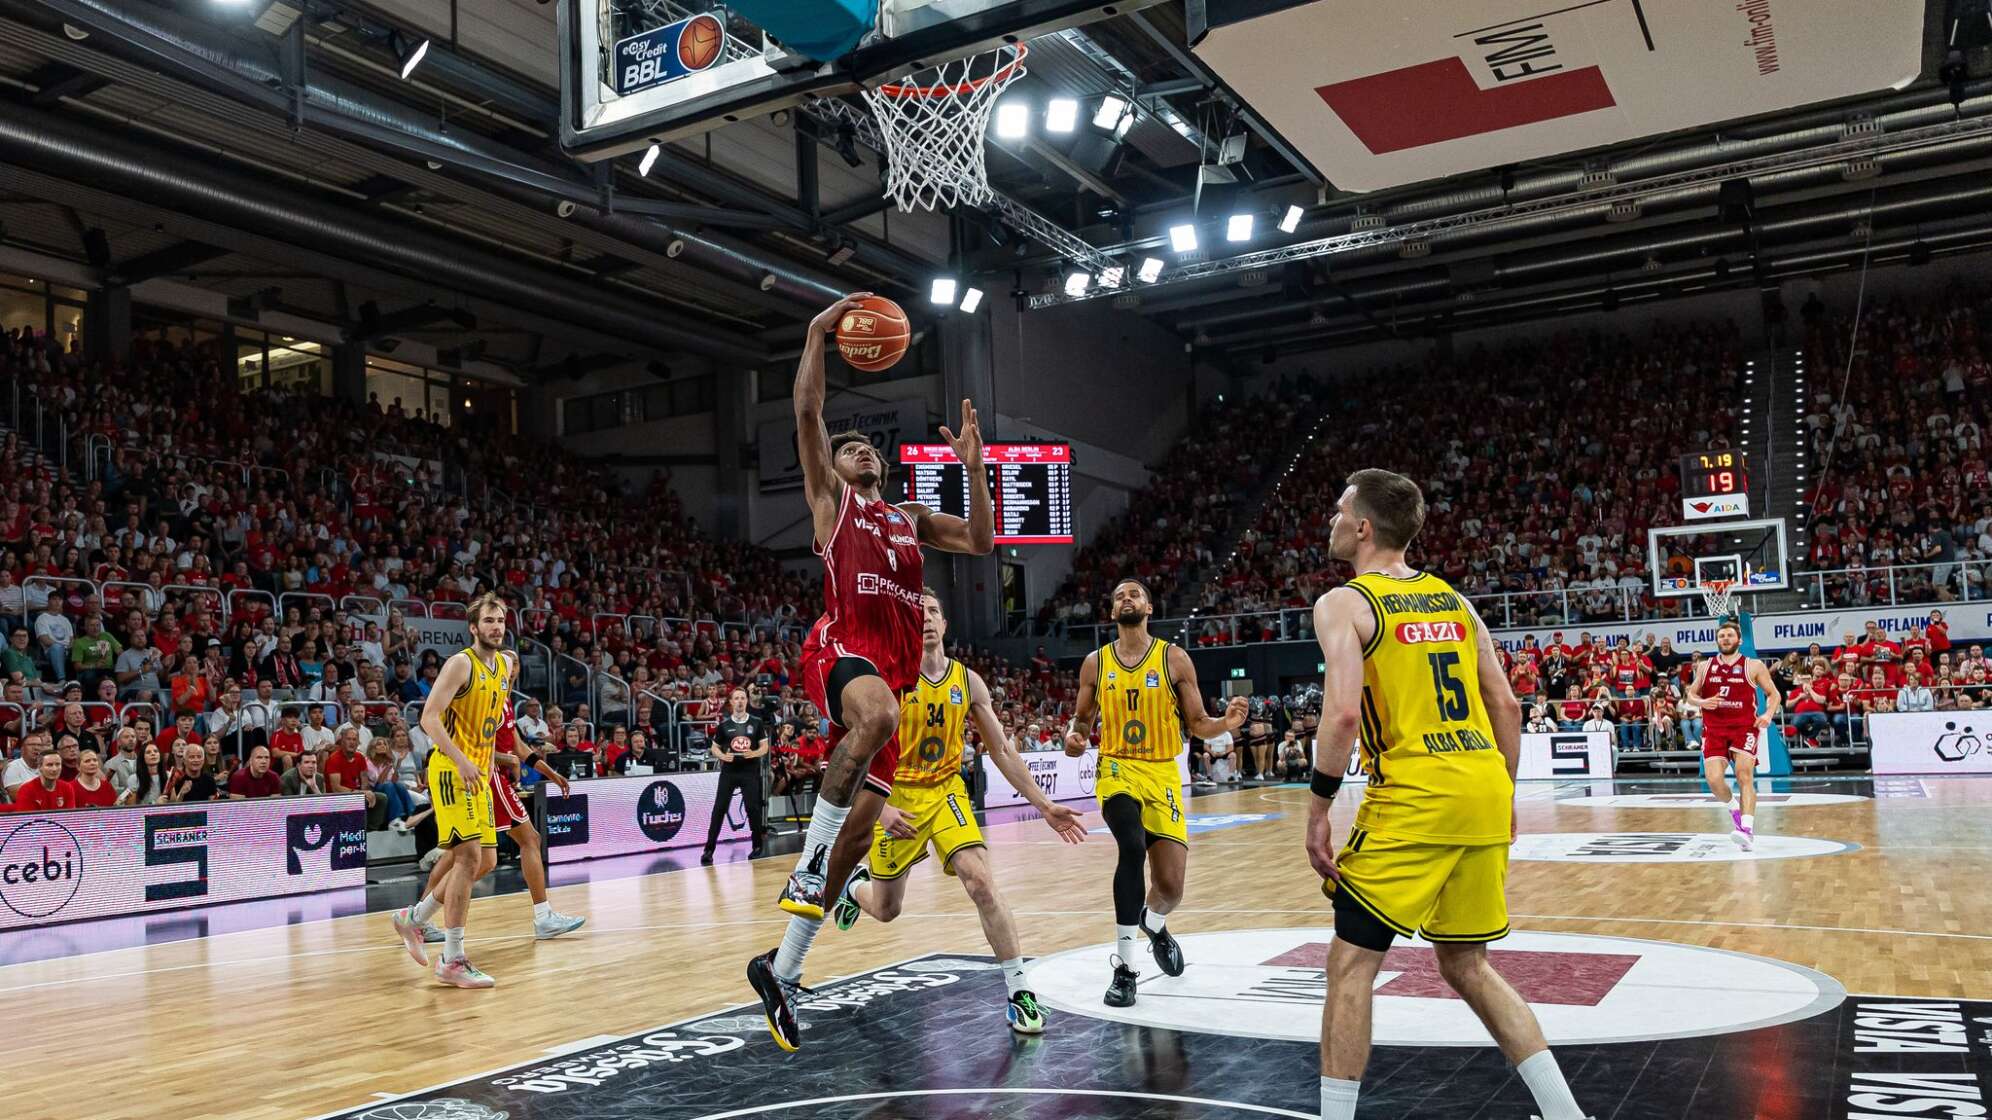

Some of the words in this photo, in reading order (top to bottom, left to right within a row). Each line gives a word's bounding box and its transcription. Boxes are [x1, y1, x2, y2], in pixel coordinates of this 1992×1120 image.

[1736, 0, 1780, 76] www.fim-onli
[636, 43, 668, 61] Credit
[1474, 24, 1563, 82] FIM
[624, 57, 668, 89] BBL
[906, 446, 919, 456] 26
[1052, 447, 1064, 456] 23
[1710, 472, 1734, 493] 19
[1713, 504, 1740, 513] AIDA
[1403, 622, 1461, 644] GAZI
[1677, 629, 1717, 644] PFLAU
[1774, 622, 1825, 639] PFLAUM
[1428, 651, 1470, 723] 15
[1126, 689, 1140, 711] 17
[927, 703, 945, 728] 34
[1423, 732, 1456, 754] ALBA
[3, 845, 72, 884] cebi
[1853, 1003, 1970, 1053] VISTA
[490, 1043, 641, 1087] BAMBERG
